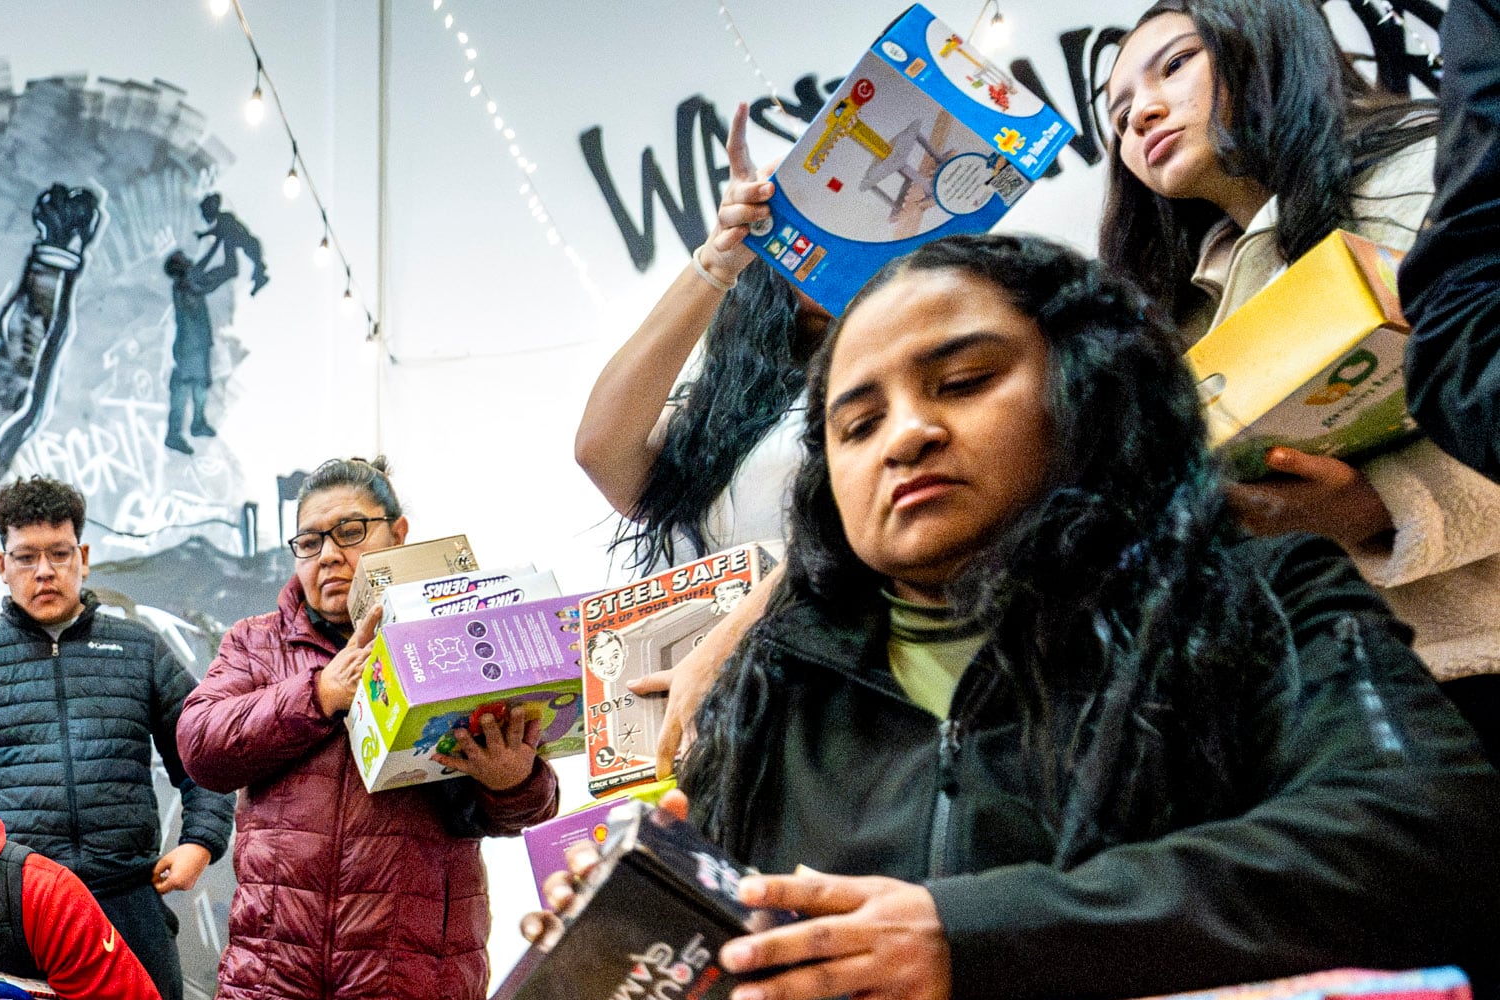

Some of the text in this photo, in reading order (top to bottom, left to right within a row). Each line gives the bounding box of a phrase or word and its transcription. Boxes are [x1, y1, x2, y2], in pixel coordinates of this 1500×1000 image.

[585, 548, 750, 623] STEEL SAFE
[587, 586, 710, 633] LOCK UP YOUR STUFF!
[403, 642, 427, 684] gymnic
[589, 693, 635, 719] TOYS
